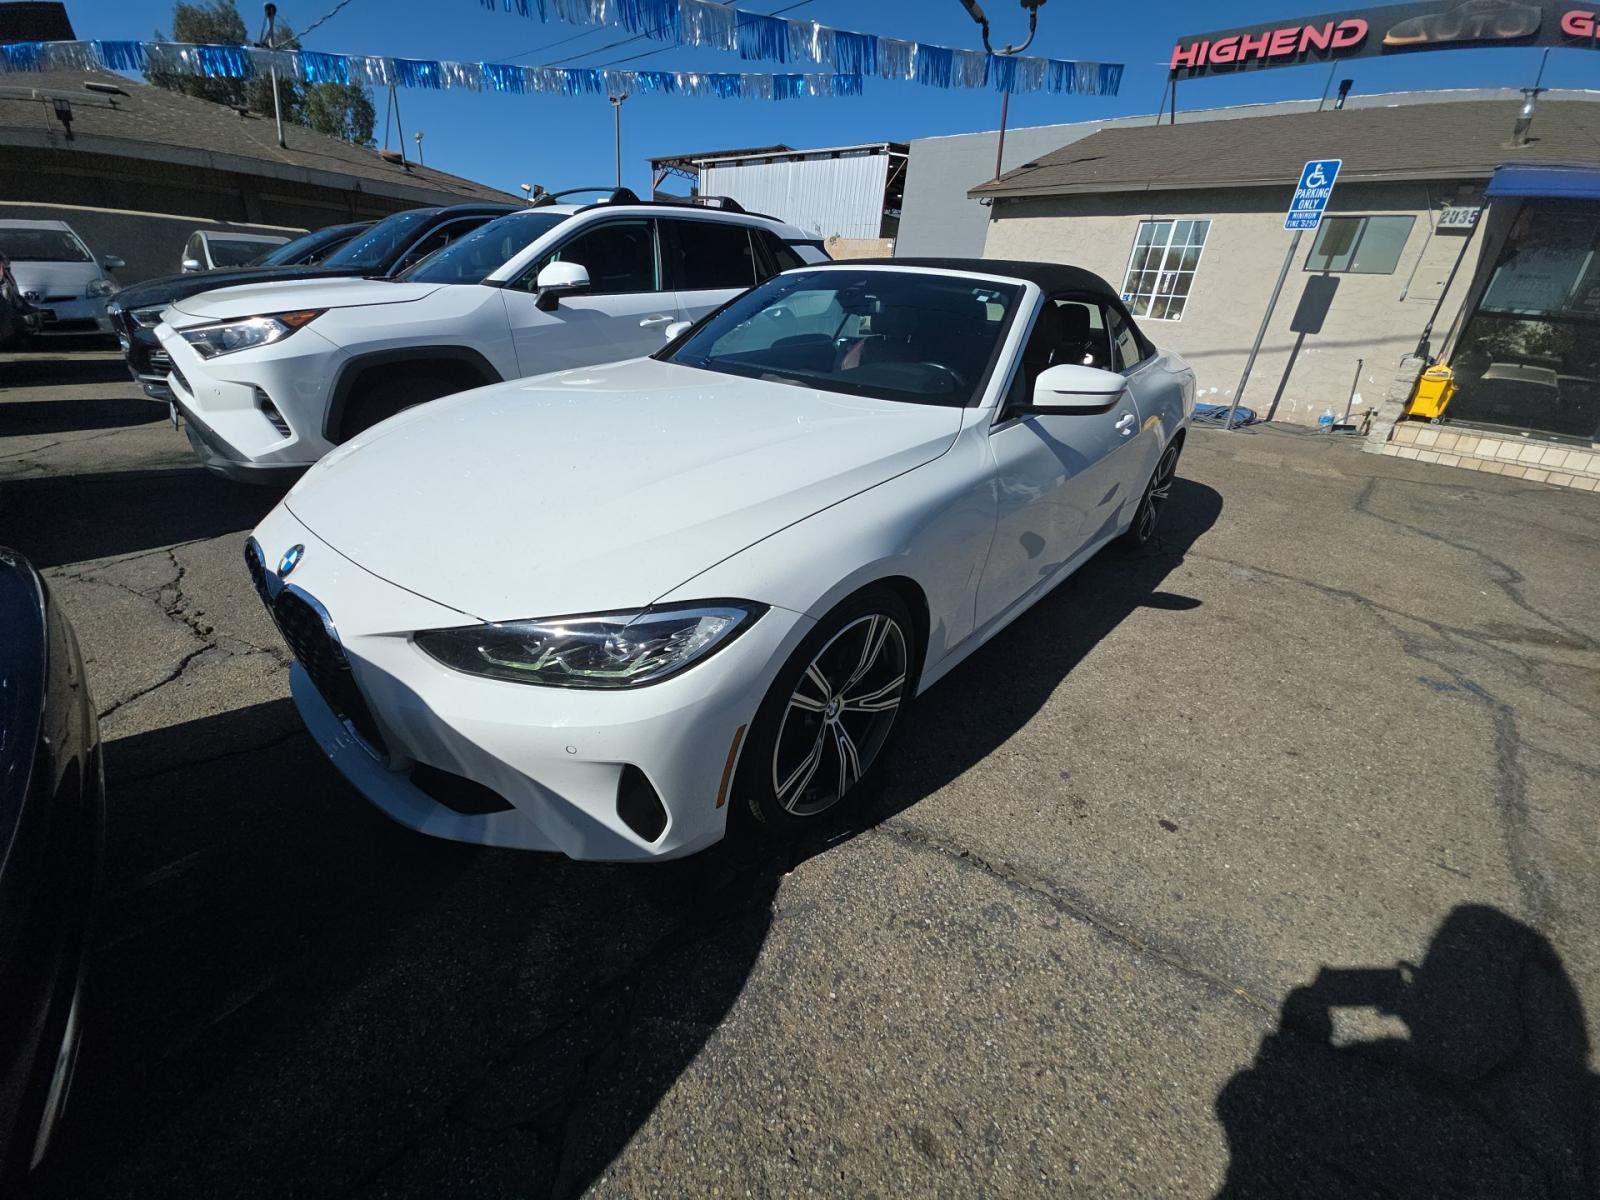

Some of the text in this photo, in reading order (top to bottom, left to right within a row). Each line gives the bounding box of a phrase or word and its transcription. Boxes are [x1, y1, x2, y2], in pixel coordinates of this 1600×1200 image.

[1170, 18, 1369, 70] HIGHEND
[1561, 9, 1600, 38] G
[1296, 188, 1330, 198] PARKING
[1298, 199, 1319, 209] ONLY
[1440, 209, 1480, 225] 2035
